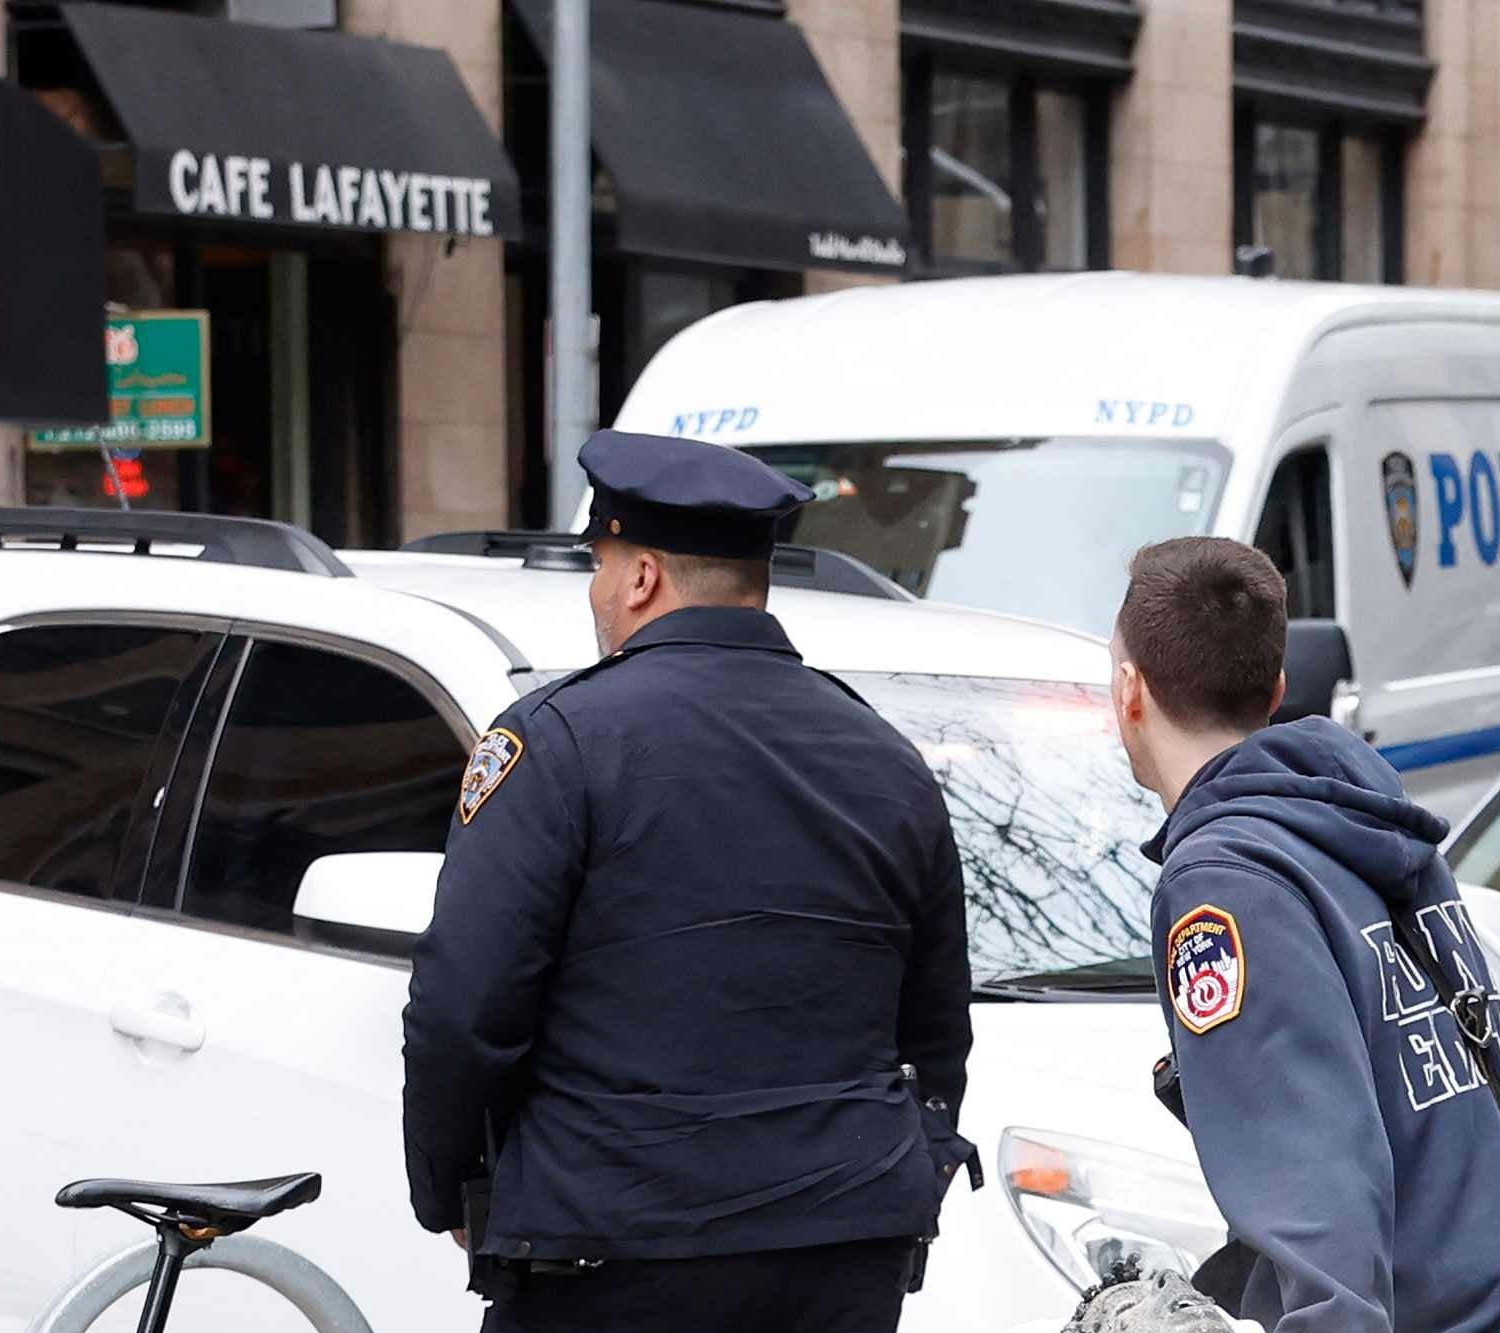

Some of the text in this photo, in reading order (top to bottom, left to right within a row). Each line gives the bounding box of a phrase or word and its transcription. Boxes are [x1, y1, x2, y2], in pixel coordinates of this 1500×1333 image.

[170, 149, 494, 236] CAFE LAFAYETTE
[668, 407, 760, 436] NYPD
[1095, 399, 1195, 427] NYPD
[1174, 921, 1227, 946] DEPARTMENT
[1178, 932, 1205, 955] CITY OF
[1192, 938, 1215, 956] YORK
